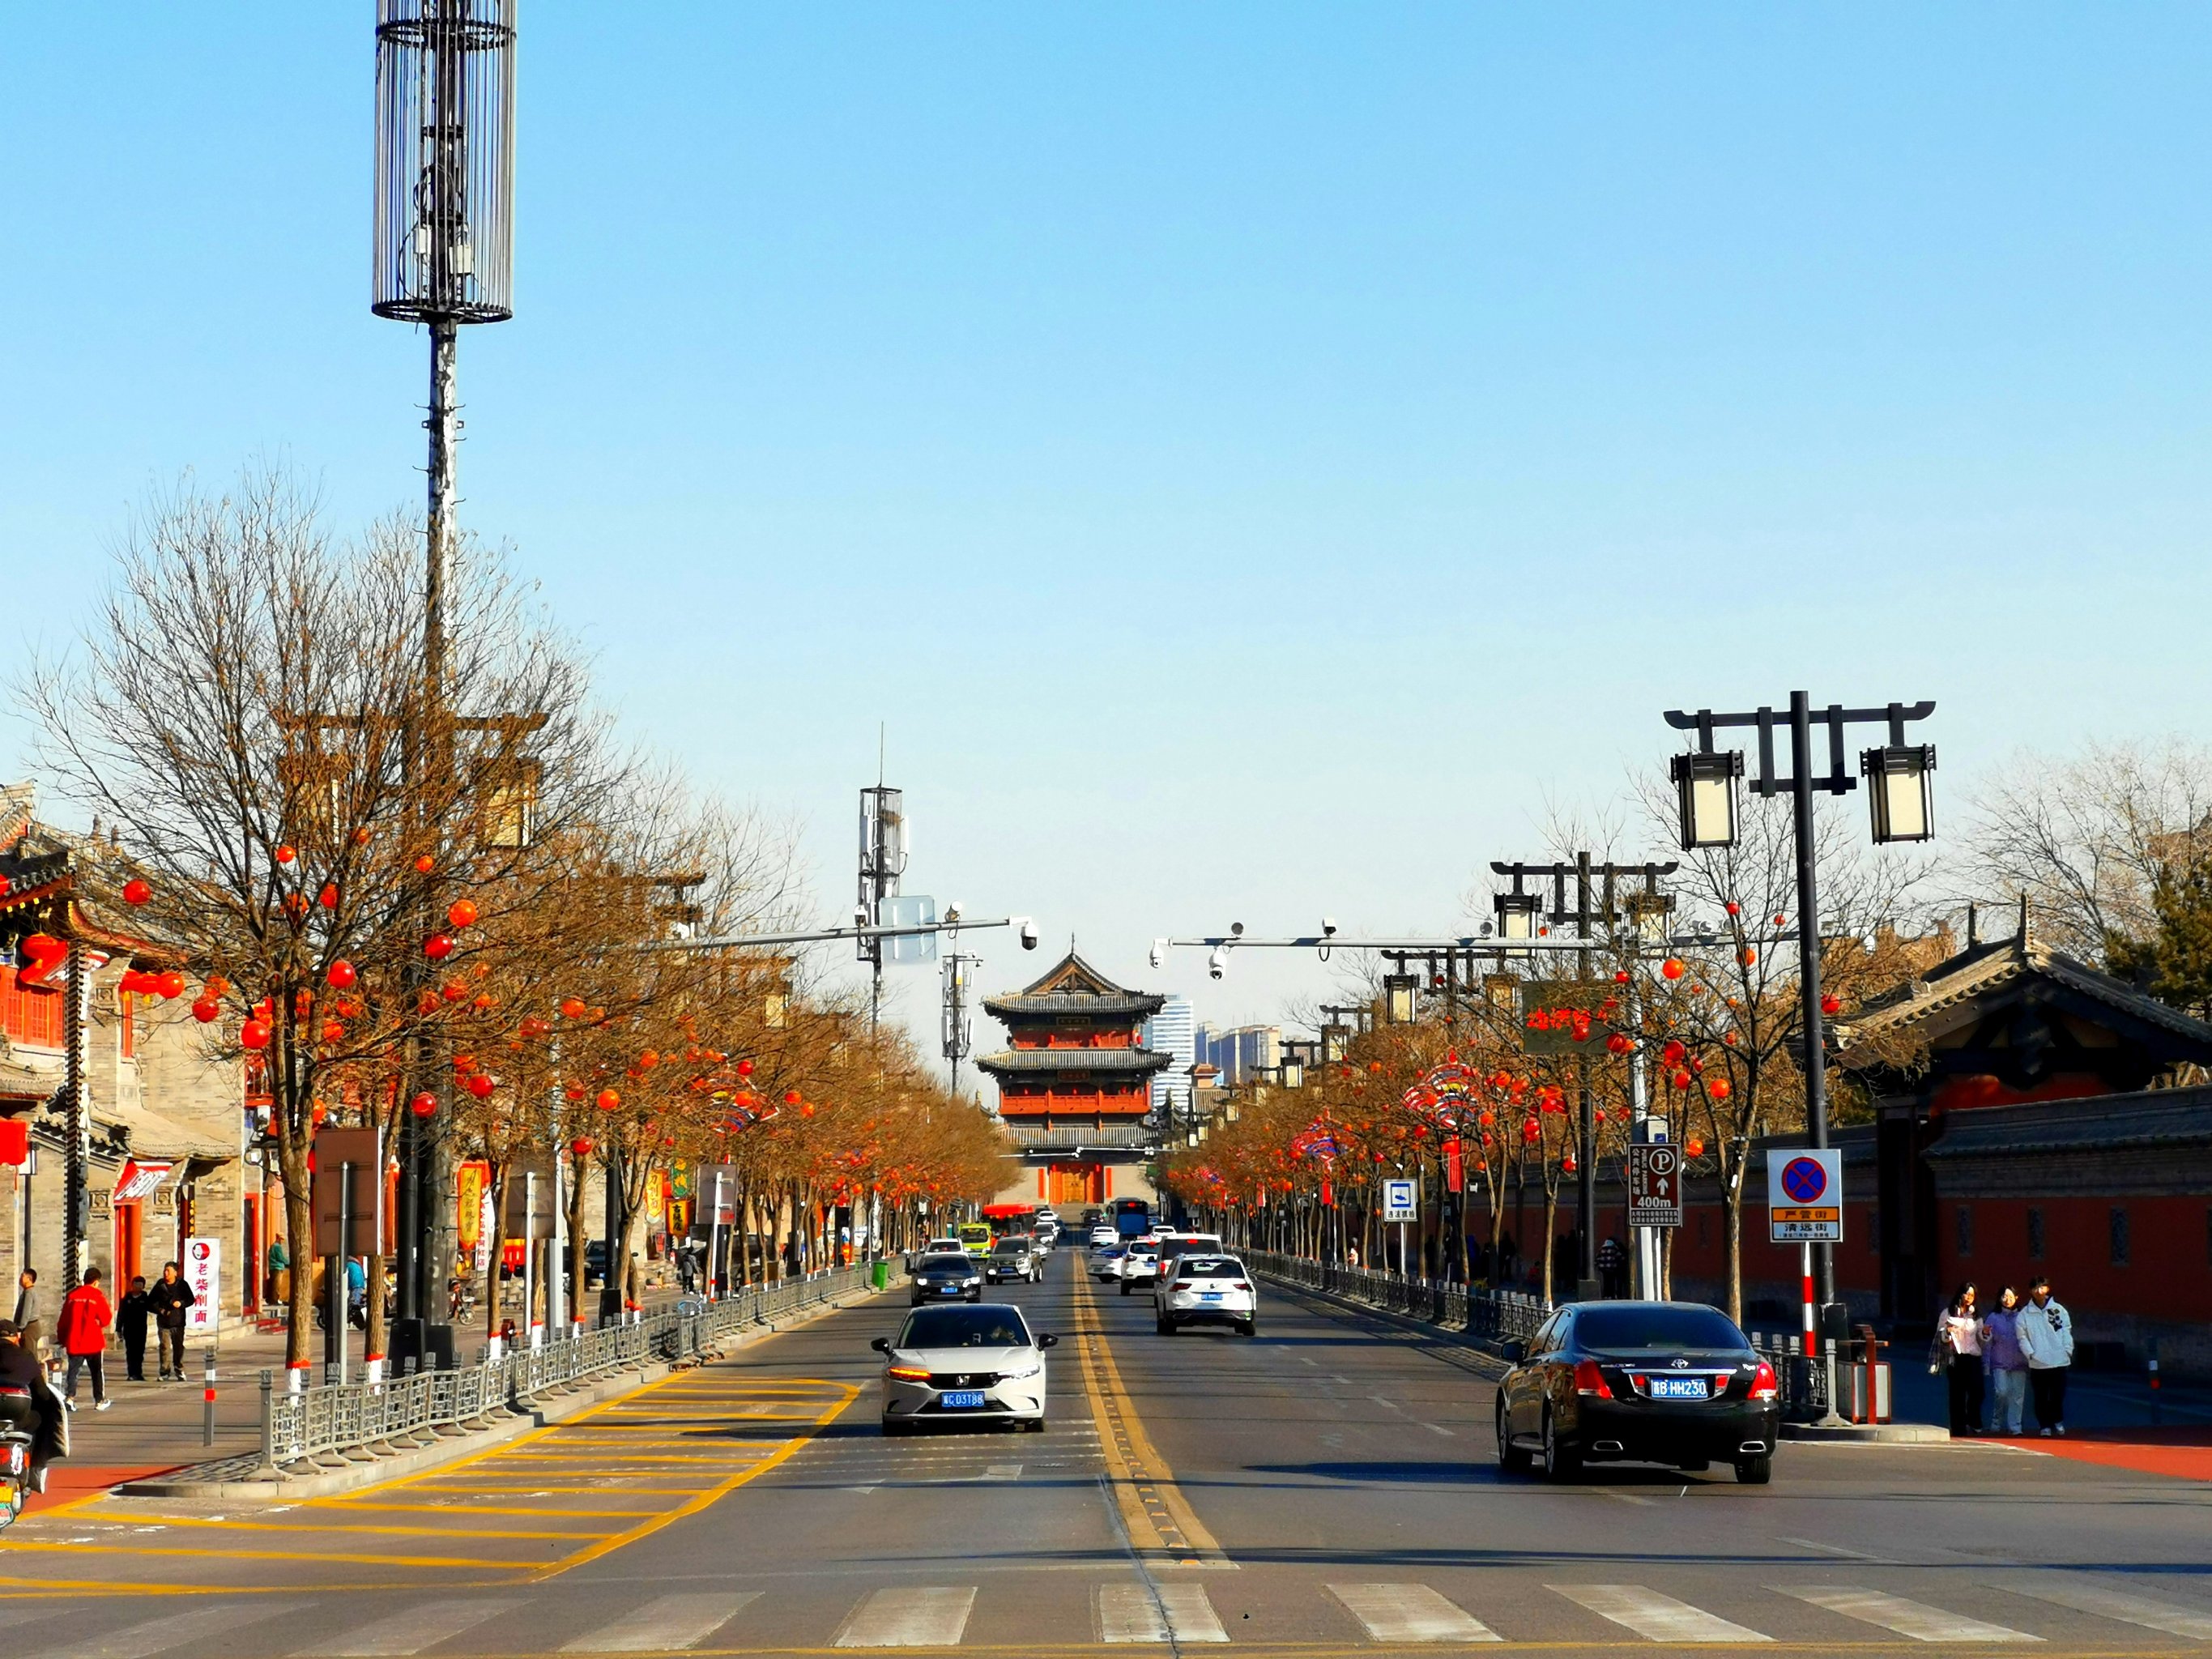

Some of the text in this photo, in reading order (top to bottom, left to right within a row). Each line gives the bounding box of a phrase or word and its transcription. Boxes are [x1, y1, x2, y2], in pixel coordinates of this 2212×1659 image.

[1656, 1153, 1670, 1171] P
[1637, 1196, 1671, 1208] 400m
[1784, 1223, 1827, 1231] 清远街
[194, 1262, 208, 1323] 老柴削面
